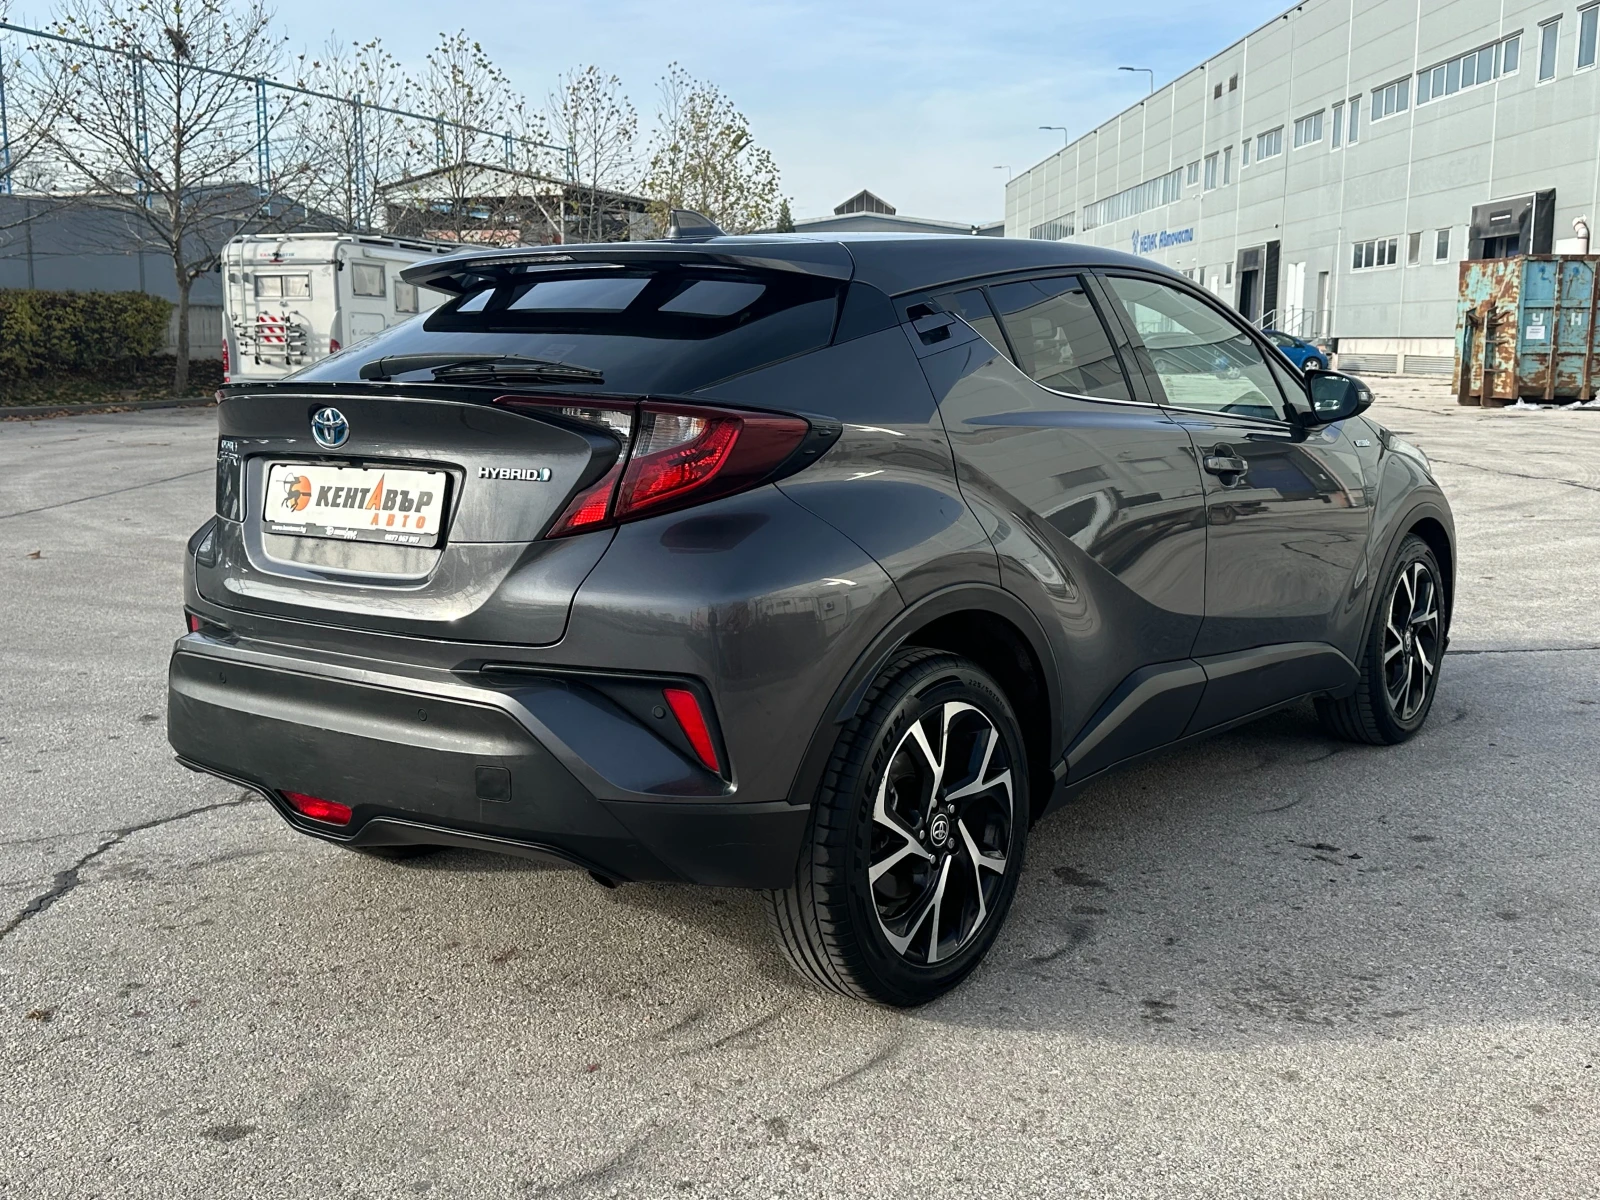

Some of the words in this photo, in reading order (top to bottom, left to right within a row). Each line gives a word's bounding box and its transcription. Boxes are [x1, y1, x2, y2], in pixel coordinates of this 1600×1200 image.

[477, 465, 537, 482] HYBRID
[315, 472, 434, 513] КЕНТАВЪР
[371, 512, 427, 529] АВТО
